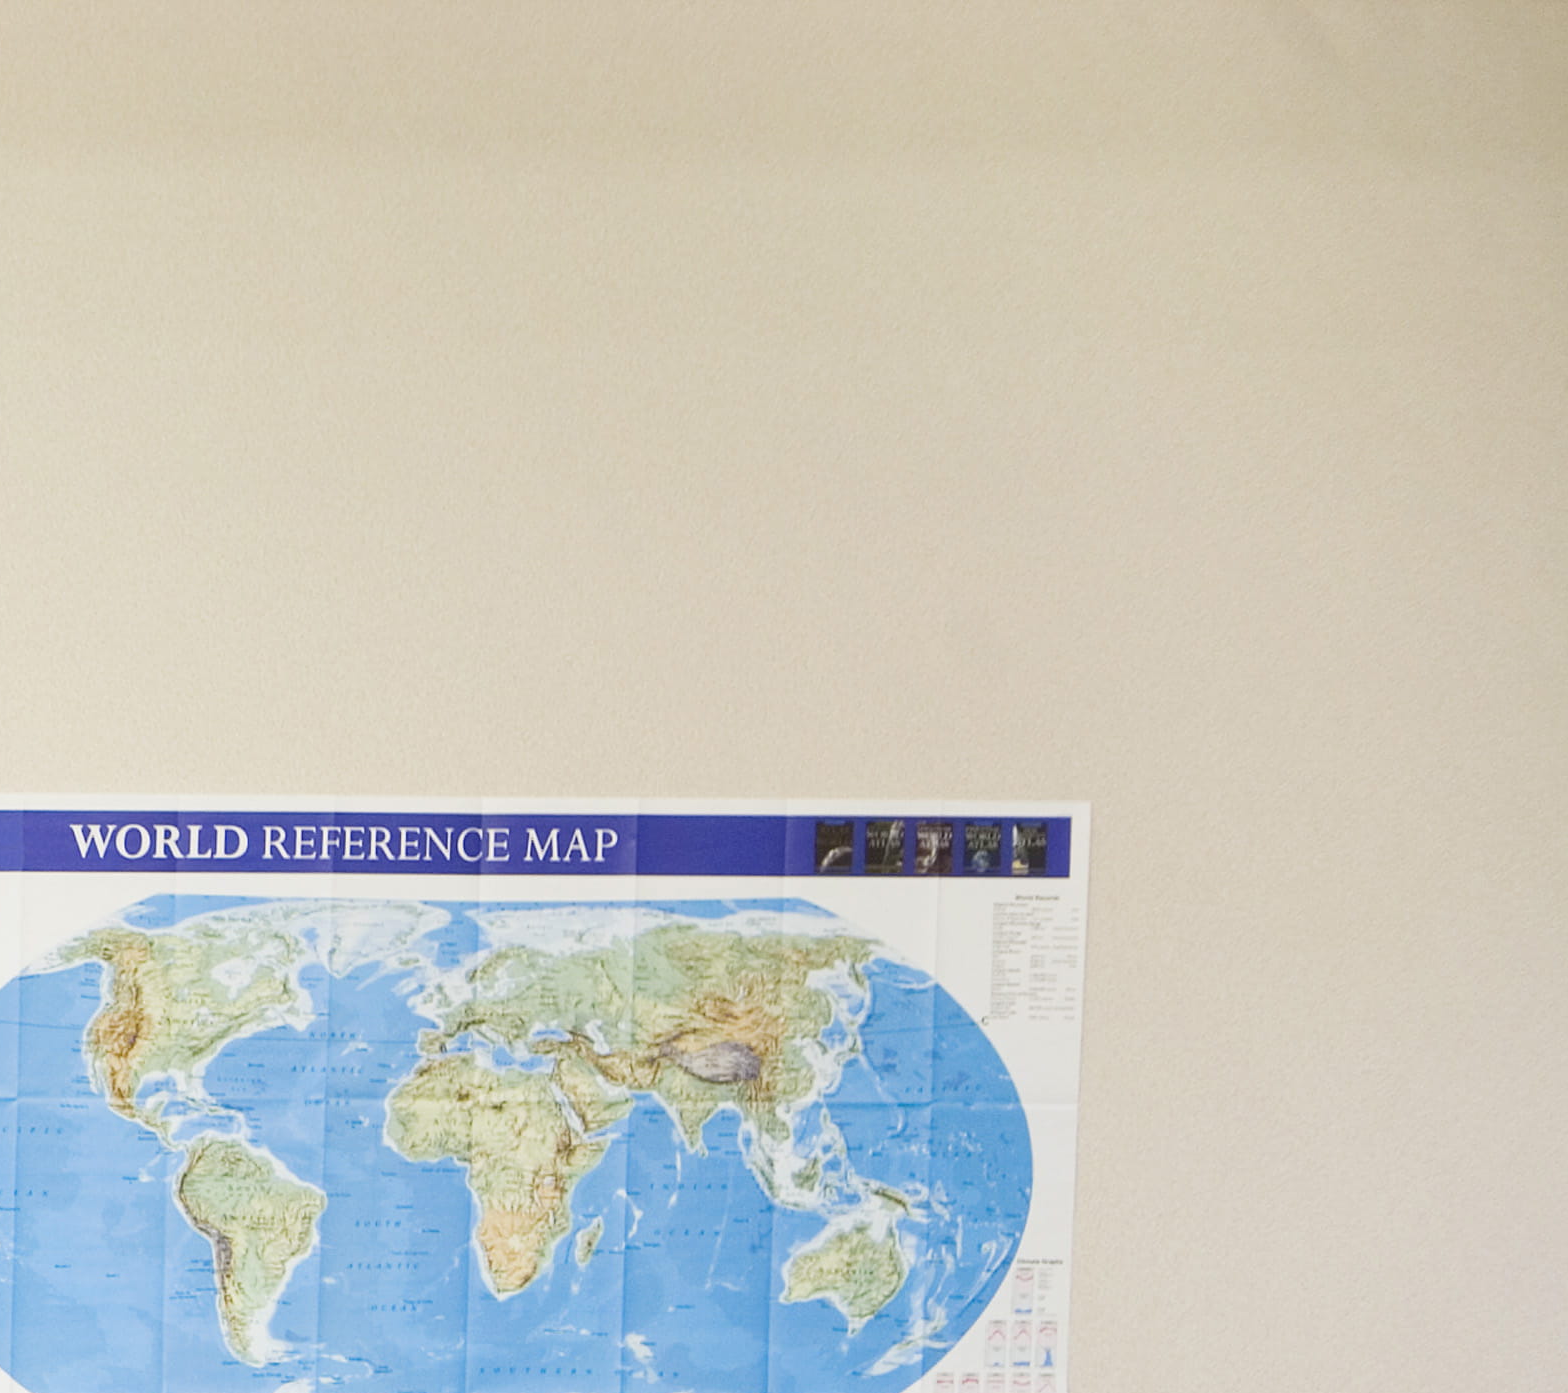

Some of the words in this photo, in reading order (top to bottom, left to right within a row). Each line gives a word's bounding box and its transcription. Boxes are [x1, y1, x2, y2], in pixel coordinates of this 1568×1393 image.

[70, 823, 249, 859] WORLD
[264, 825, 520, 863] REFERENCE
[524, 827, 620, 863] MAP
